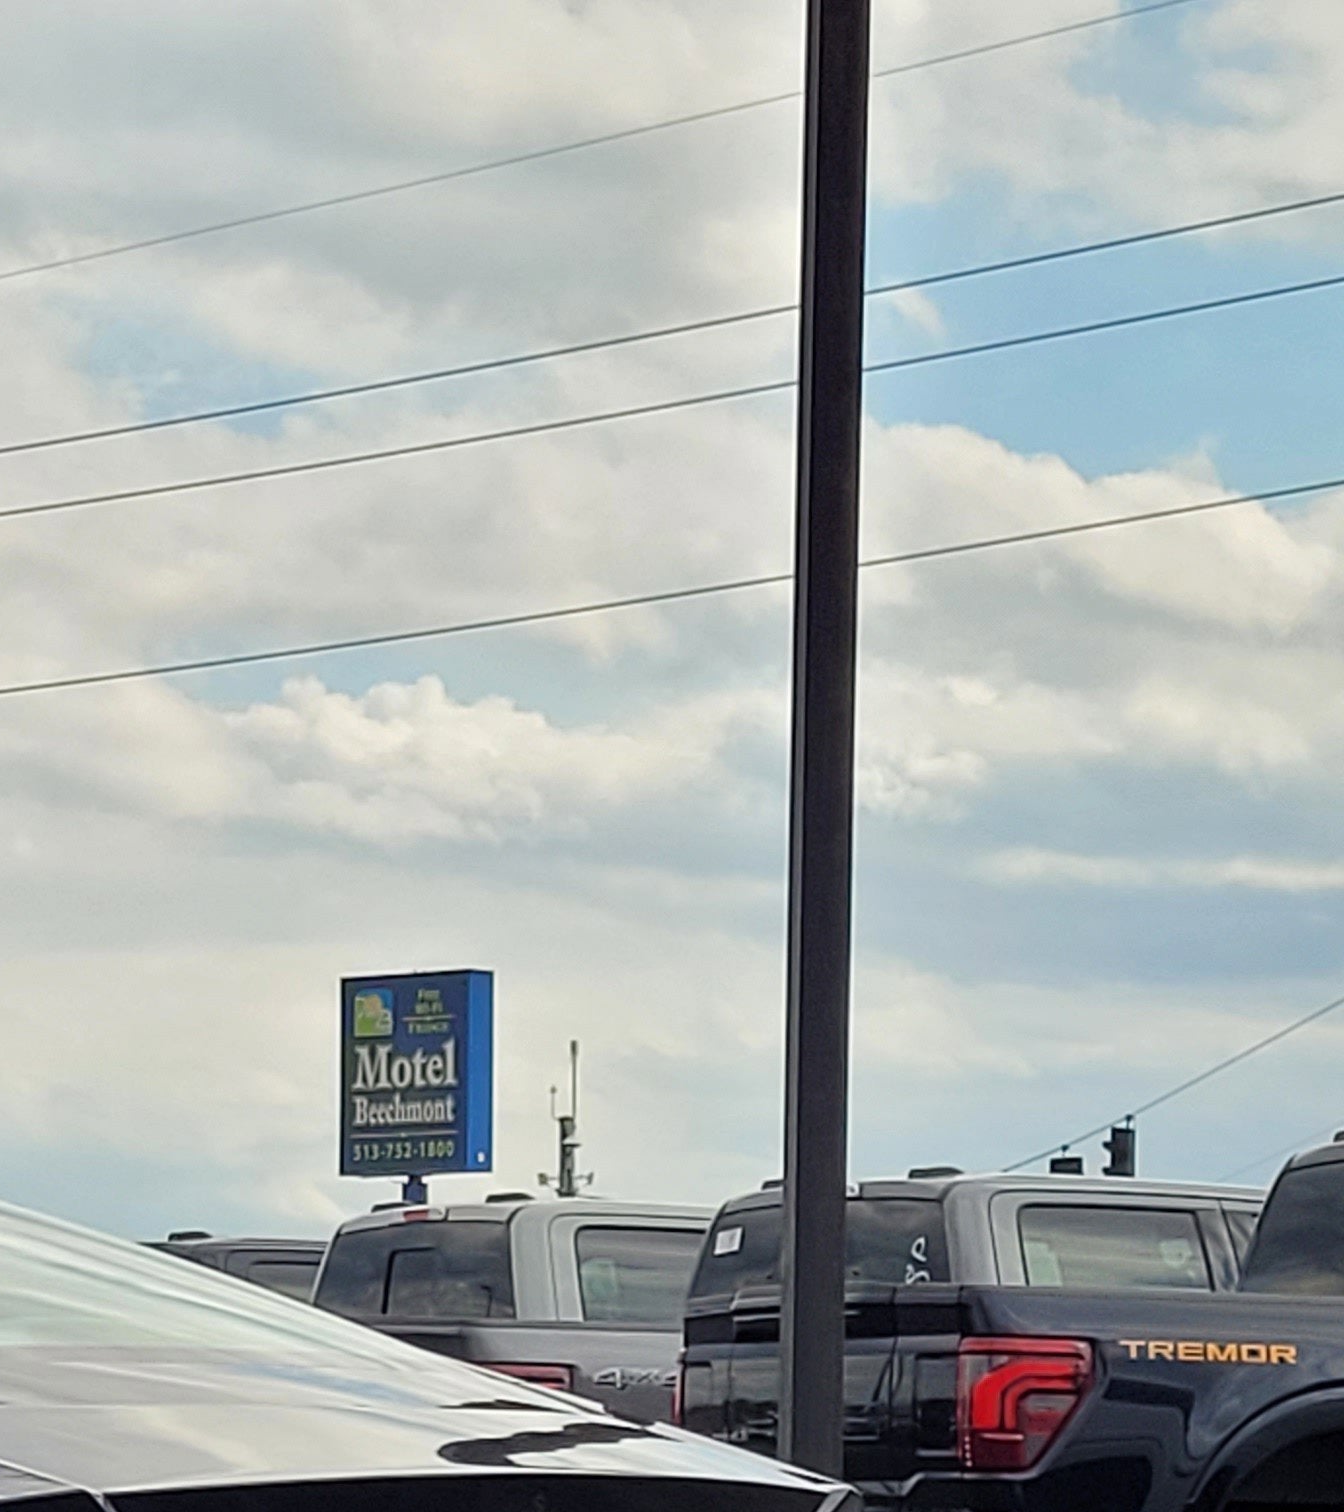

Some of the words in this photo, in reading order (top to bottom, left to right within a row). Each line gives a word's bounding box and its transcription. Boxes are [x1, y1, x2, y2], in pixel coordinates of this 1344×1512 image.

[352, 1038, 458, 1090] Motel
[352, 1093, 455, 1125] Beechmont
[1118, 1339, 1298, 1365] TREMOR
